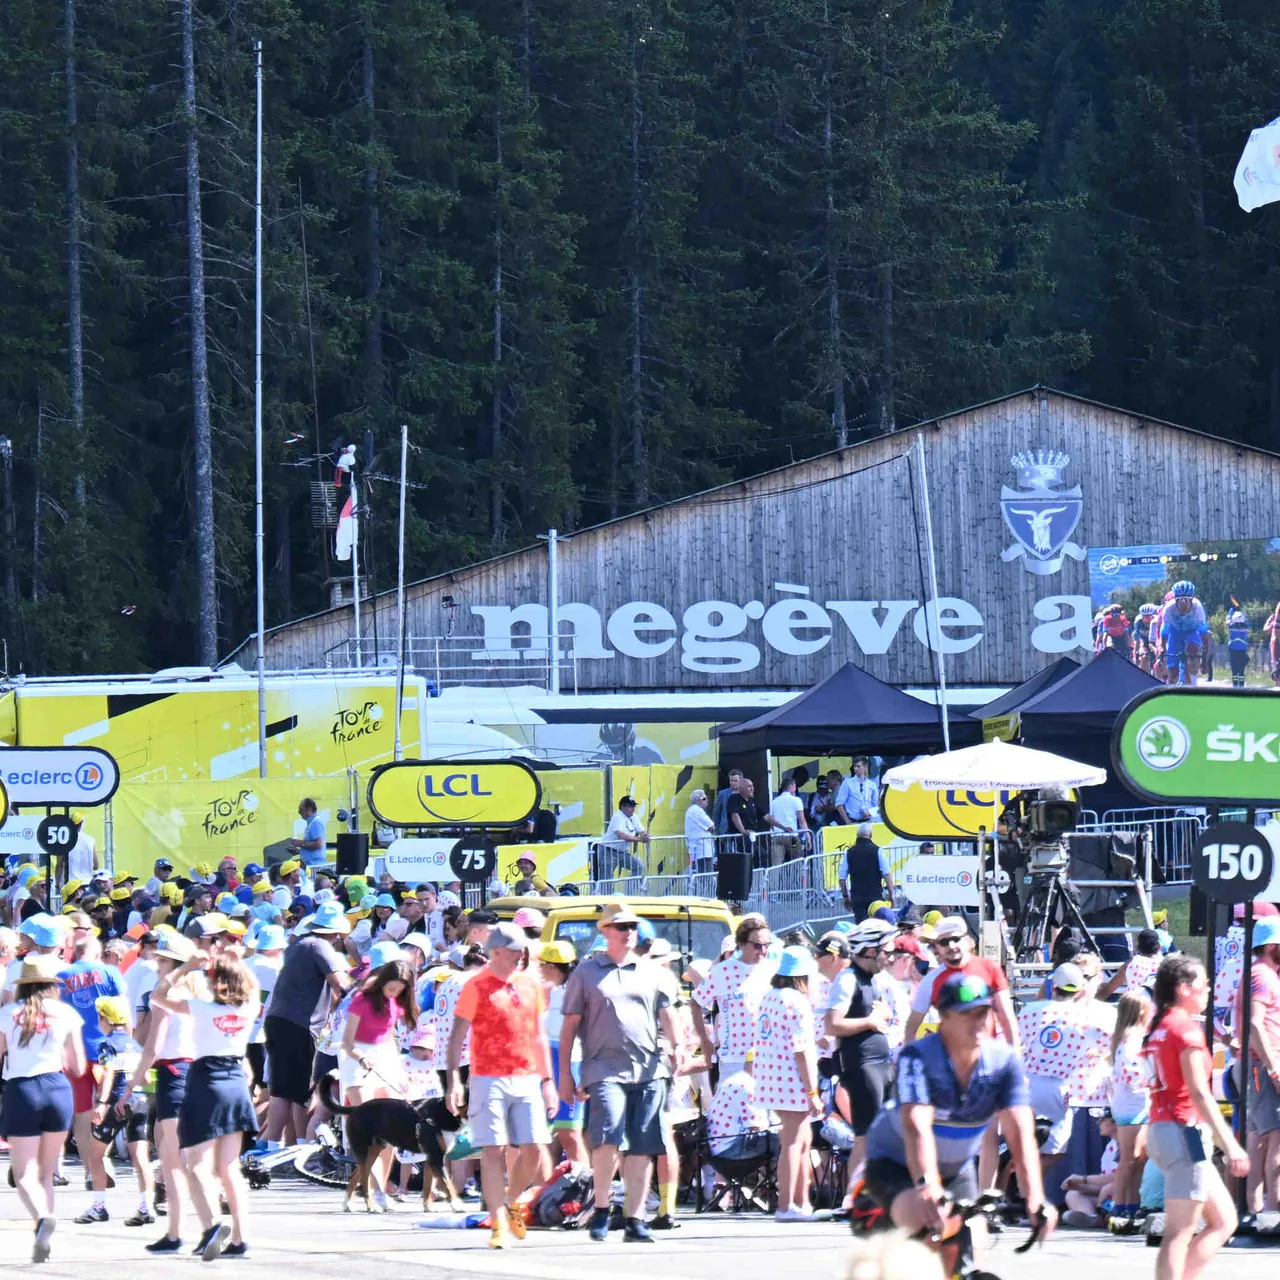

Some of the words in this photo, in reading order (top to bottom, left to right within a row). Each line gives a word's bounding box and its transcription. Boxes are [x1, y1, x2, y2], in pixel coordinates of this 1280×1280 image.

[470, 581, 985, 674] megève
[424, 773, 493, 797] LCL
[47, 826, 70, 845] 50
[389, 854, 433, 864] E.Leclerc
[460, 849, 486, 870] 75
[1201, 842, 1264, 882] 150
[906, 874, 957, 884] E.Leclerc
